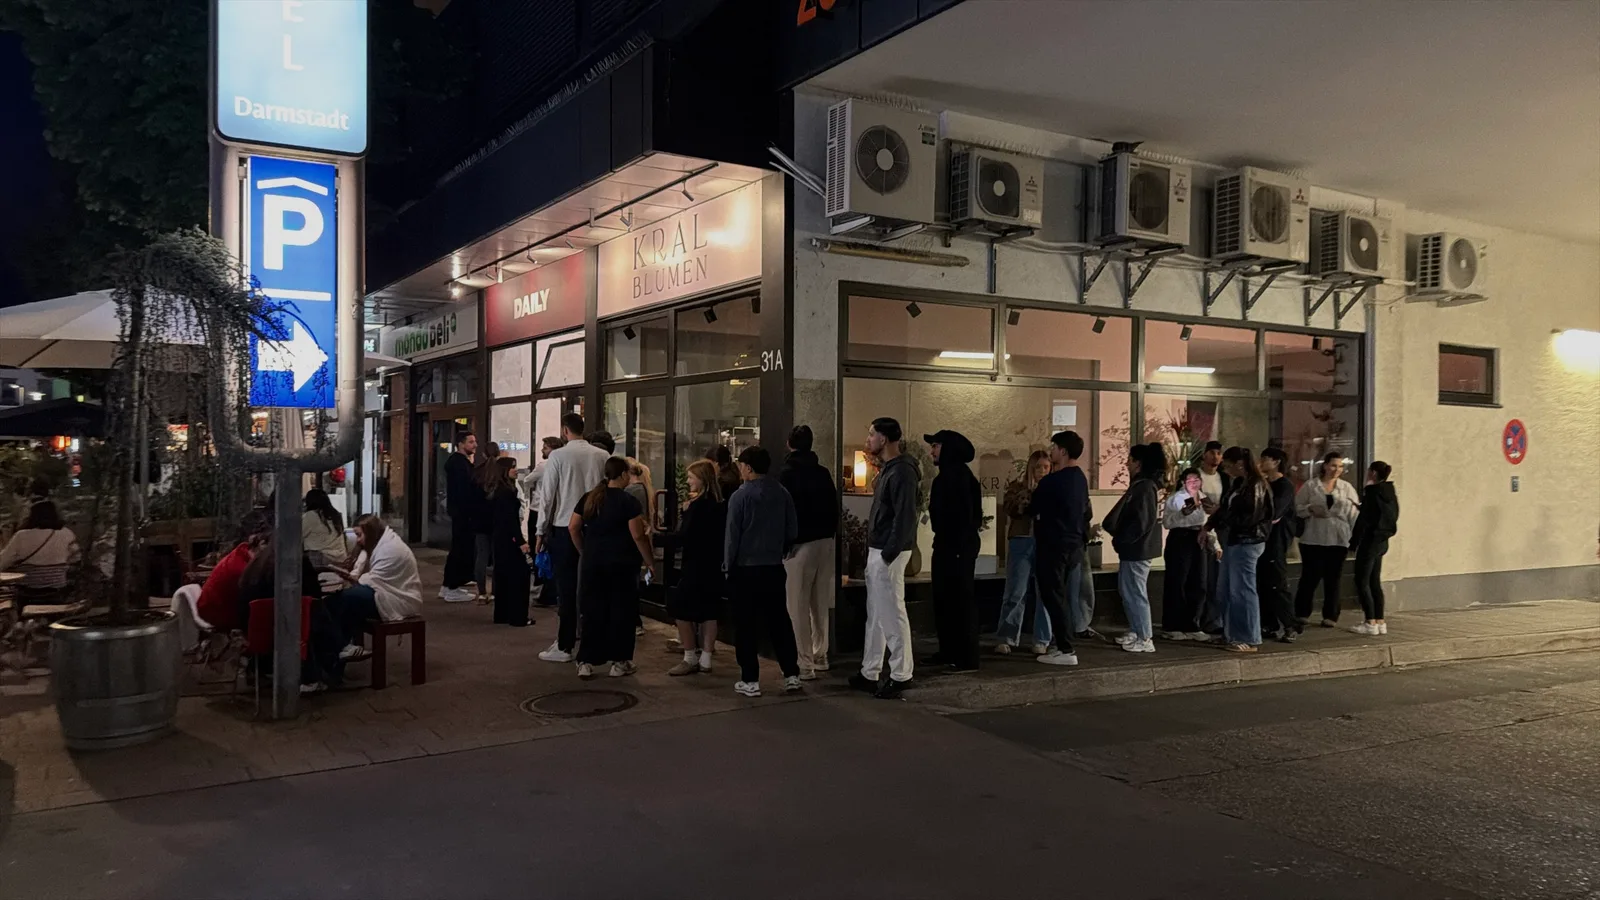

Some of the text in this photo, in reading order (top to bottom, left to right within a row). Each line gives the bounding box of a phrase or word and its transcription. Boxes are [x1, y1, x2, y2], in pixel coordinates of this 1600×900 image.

[233, 95, 349, 131] Darmstadt
[263, 193, 324, 271] P
[633, 213, 708, 270] KRAL
[633, 254, 708, 299] BLUMEN
[513, 288, 550, 319] DAILY
[761, 349, 784, 372] 31A
